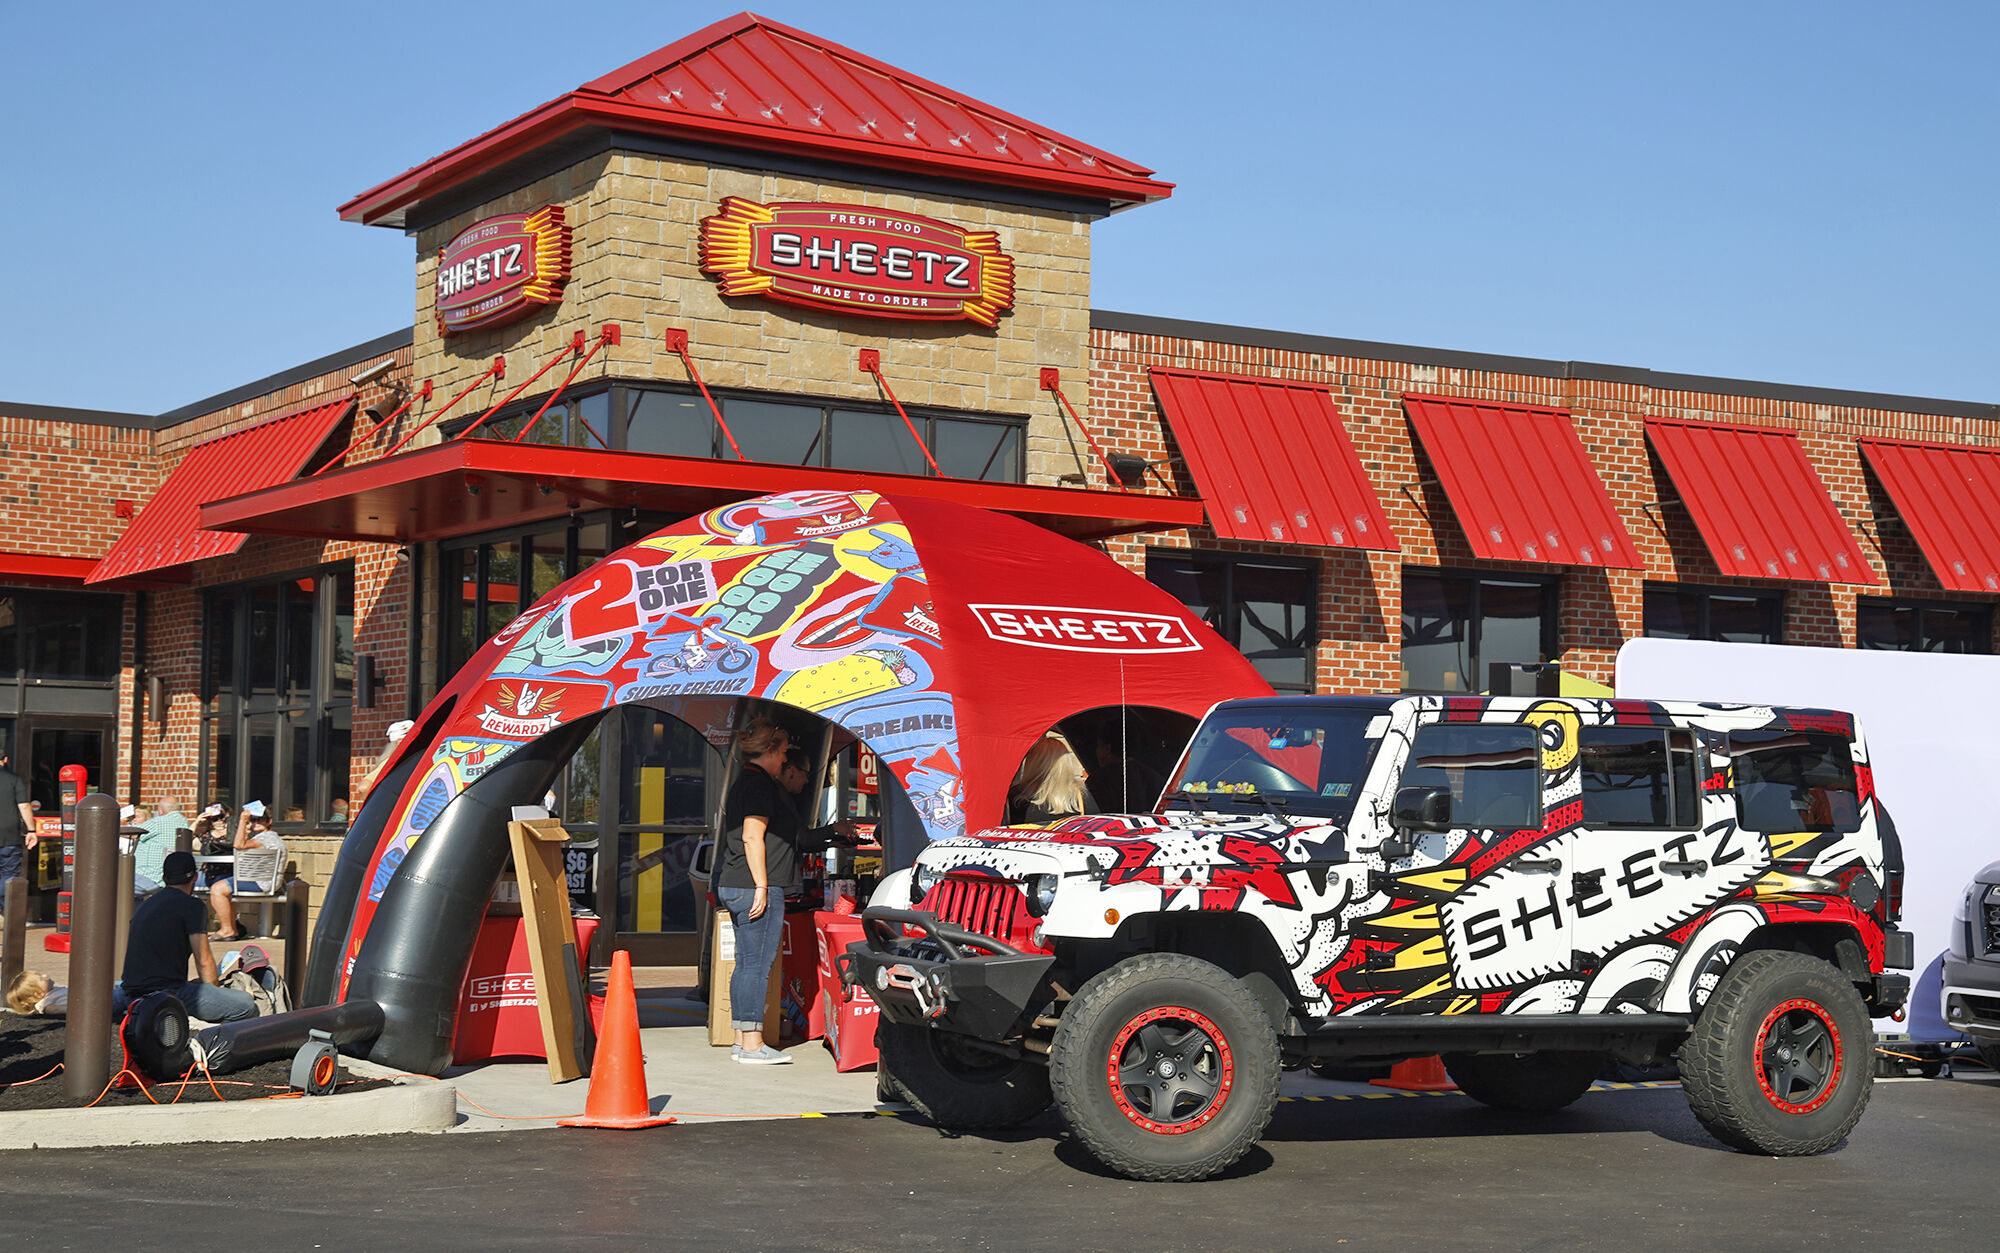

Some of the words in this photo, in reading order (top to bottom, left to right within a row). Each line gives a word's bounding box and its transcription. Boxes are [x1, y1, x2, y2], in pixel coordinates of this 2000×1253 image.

[460, 232, 479, 247] FRESH
[481, 226, 499, 237] FOOD
[830, 213, 876, 226] FRESH
[886, 220, 922, 234] FOOD
[438, 243, 523, 300] SHEETZ
[771, 232, 970, 289] SHEETZ
[481, 295, 504, 309] ORDER
[812, 284, 851, 299] MADE
[858, 291, 876, 303] TO
[883, 295, 928, 307] ORDER
[636, 562, 706, 591] FOR
[570, 562, 640, 641] 2
[639, 579, 708, 611] ONE
[724, 552, 830, 636] BOOM
[989, 612, 1183, 644] SHEETZ
[622, 683, 682, 701] SUPER
[682, 677, 749, 696] FREAKZ
[485, 719, 547, 735] REWARDZ
[848, 714, 953, 740] FREAK!
[1463, 817, 1746, 961] SHEETZ
